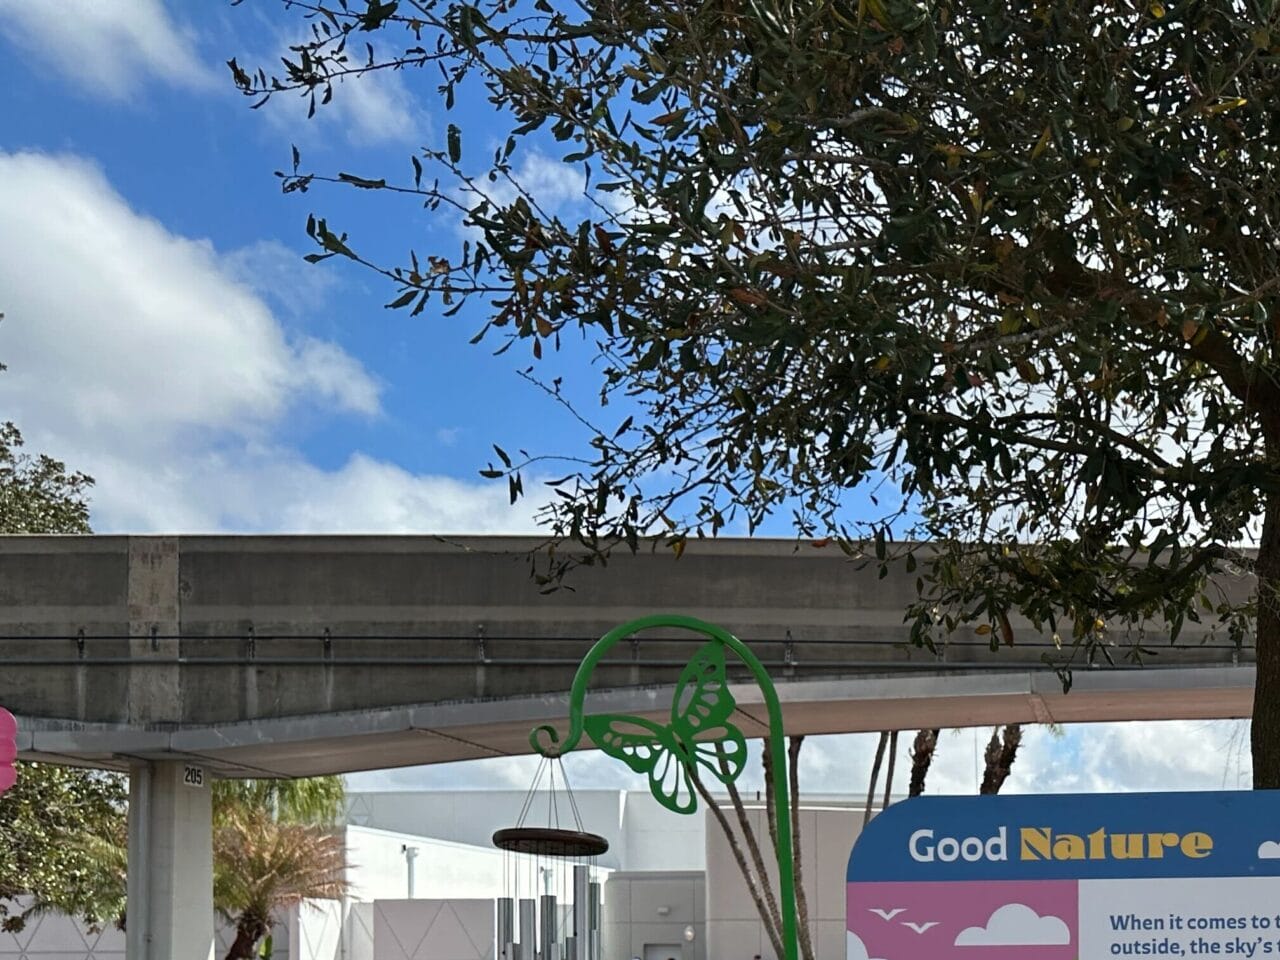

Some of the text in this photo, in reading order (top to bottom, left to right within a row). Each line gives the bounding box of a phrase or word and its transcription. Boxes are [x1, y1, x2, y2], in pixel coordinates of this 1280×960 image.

[185, 767, 202, 785] 205
[908, 825, 1214, 863] Good Nature
[1109, 913, 1165, 931] When
[1169, 913, 1184, 930] it
[1187, 917, 1247, 930] comes
[1250, 914, 1271, 930] to
[1110, 937, 1186, 957] outside,
[1189, 937, 1221, 955] the
